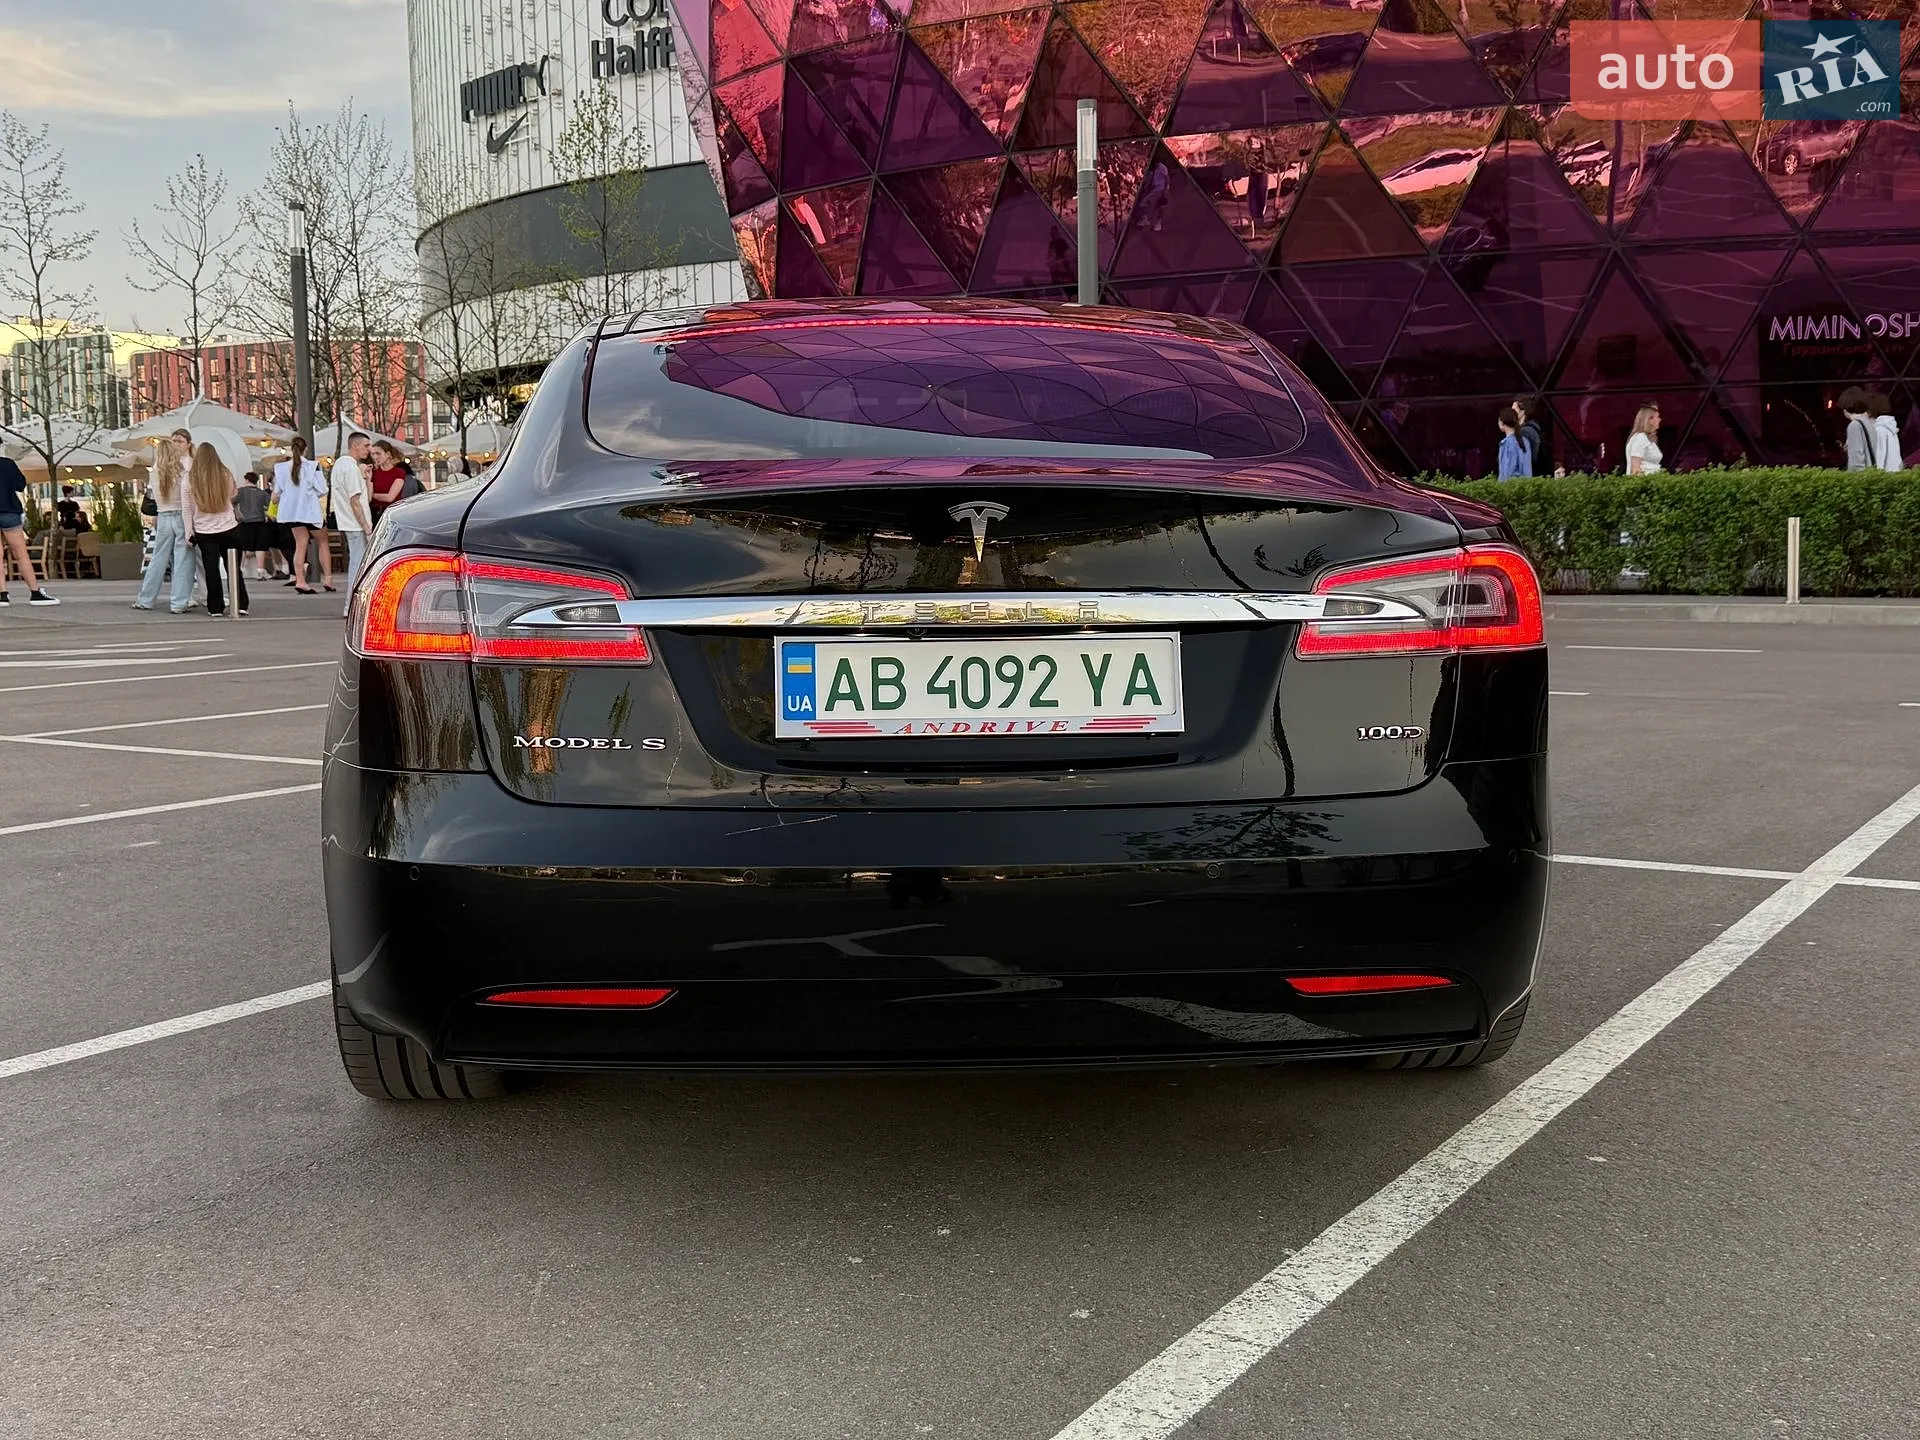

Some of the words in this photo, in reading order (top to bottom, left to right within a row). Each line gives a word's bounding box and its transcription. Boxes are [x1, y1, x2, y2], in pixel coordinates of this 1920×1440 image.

[460, 64, 522, 124] PUMA
[860, 600, 1099, 624] TESLA
[824, 656, 908, 712] AB
[926, 653, 1059, 711] 4092
[1080, 652, 1163, 707] YA
[787, 694, 813, 712] UA
[893, 720, 1070, 735] ANDRIVE
[1357, 725, 1425, 741] 100D
[512, 735, 633, 750] MODEL
[642, 737, 666, 751] S
